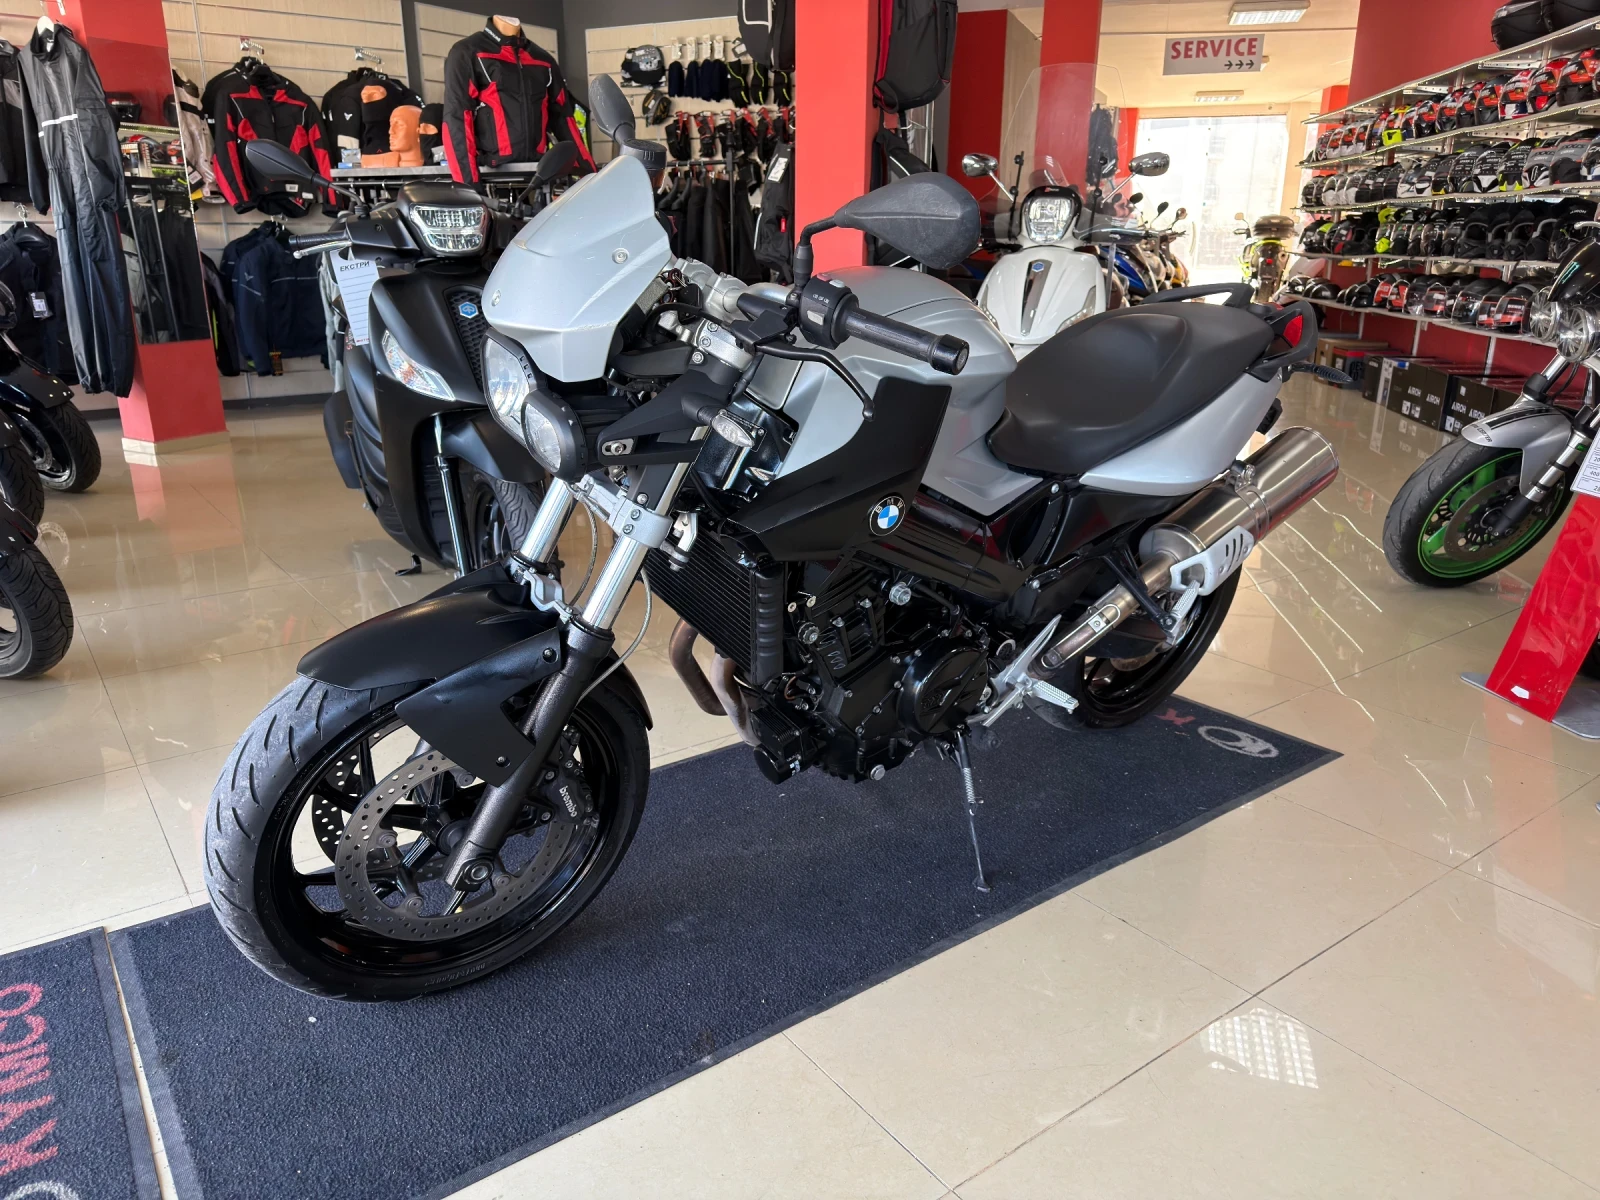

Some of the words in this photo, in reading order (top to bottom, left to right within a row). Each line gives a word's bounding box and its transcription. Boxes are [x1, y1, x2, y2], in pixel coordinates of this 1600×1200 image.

[1171, 38, 1258, 59] SERVICE
[340, 261, 370, 272] ЕКСТРИ
[1407, 386, 1422, 397] AIROH
[1426, 393, 1440, 406] AIROH
[1451, 401, 1467, 414] AIROH
[876, 498, 904, 513] BMW
[559, 785, 577, 817] brembo
